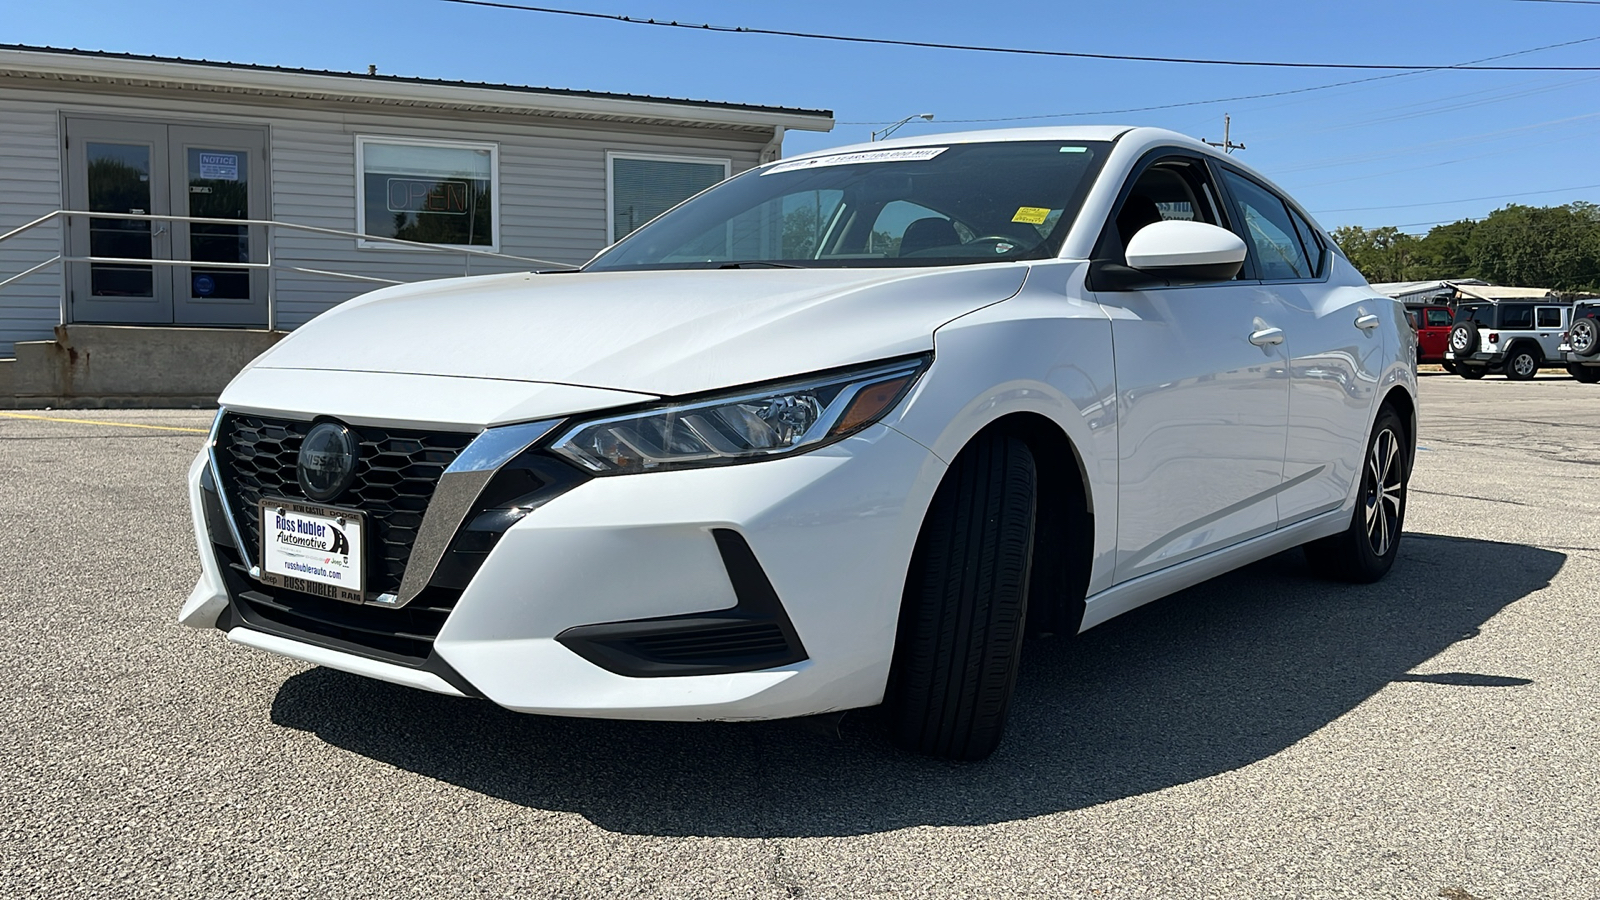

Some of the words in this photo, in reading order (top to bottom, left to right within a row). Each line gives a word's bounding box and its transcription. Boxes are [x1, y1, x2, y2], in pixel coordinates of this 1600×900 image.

[202, 156, 235, 165] NOTICE
[390, 182, 464, 211] OPEN
[307, 455, 344, 469] NISSAN
[292, 504, 304, 513] NEW
[305, 506, 325, 516] CASTLE
[329, 510, 360, 520] DODGE
[275, 515, 295, 533] Russ
[297, 518, 326, 538] Hubler
[276, 530, 327, 550] Automotive
[284, 560, 342, 580] russhublerauto.com
[330, 557, 343, 567] Jeep
[262, 573, 278, 585] Jeep
[283, 576, 305, 592] RUSS
[306, 581, 338, 599] HUBLER
[341, 591, 361, 602] RAM
